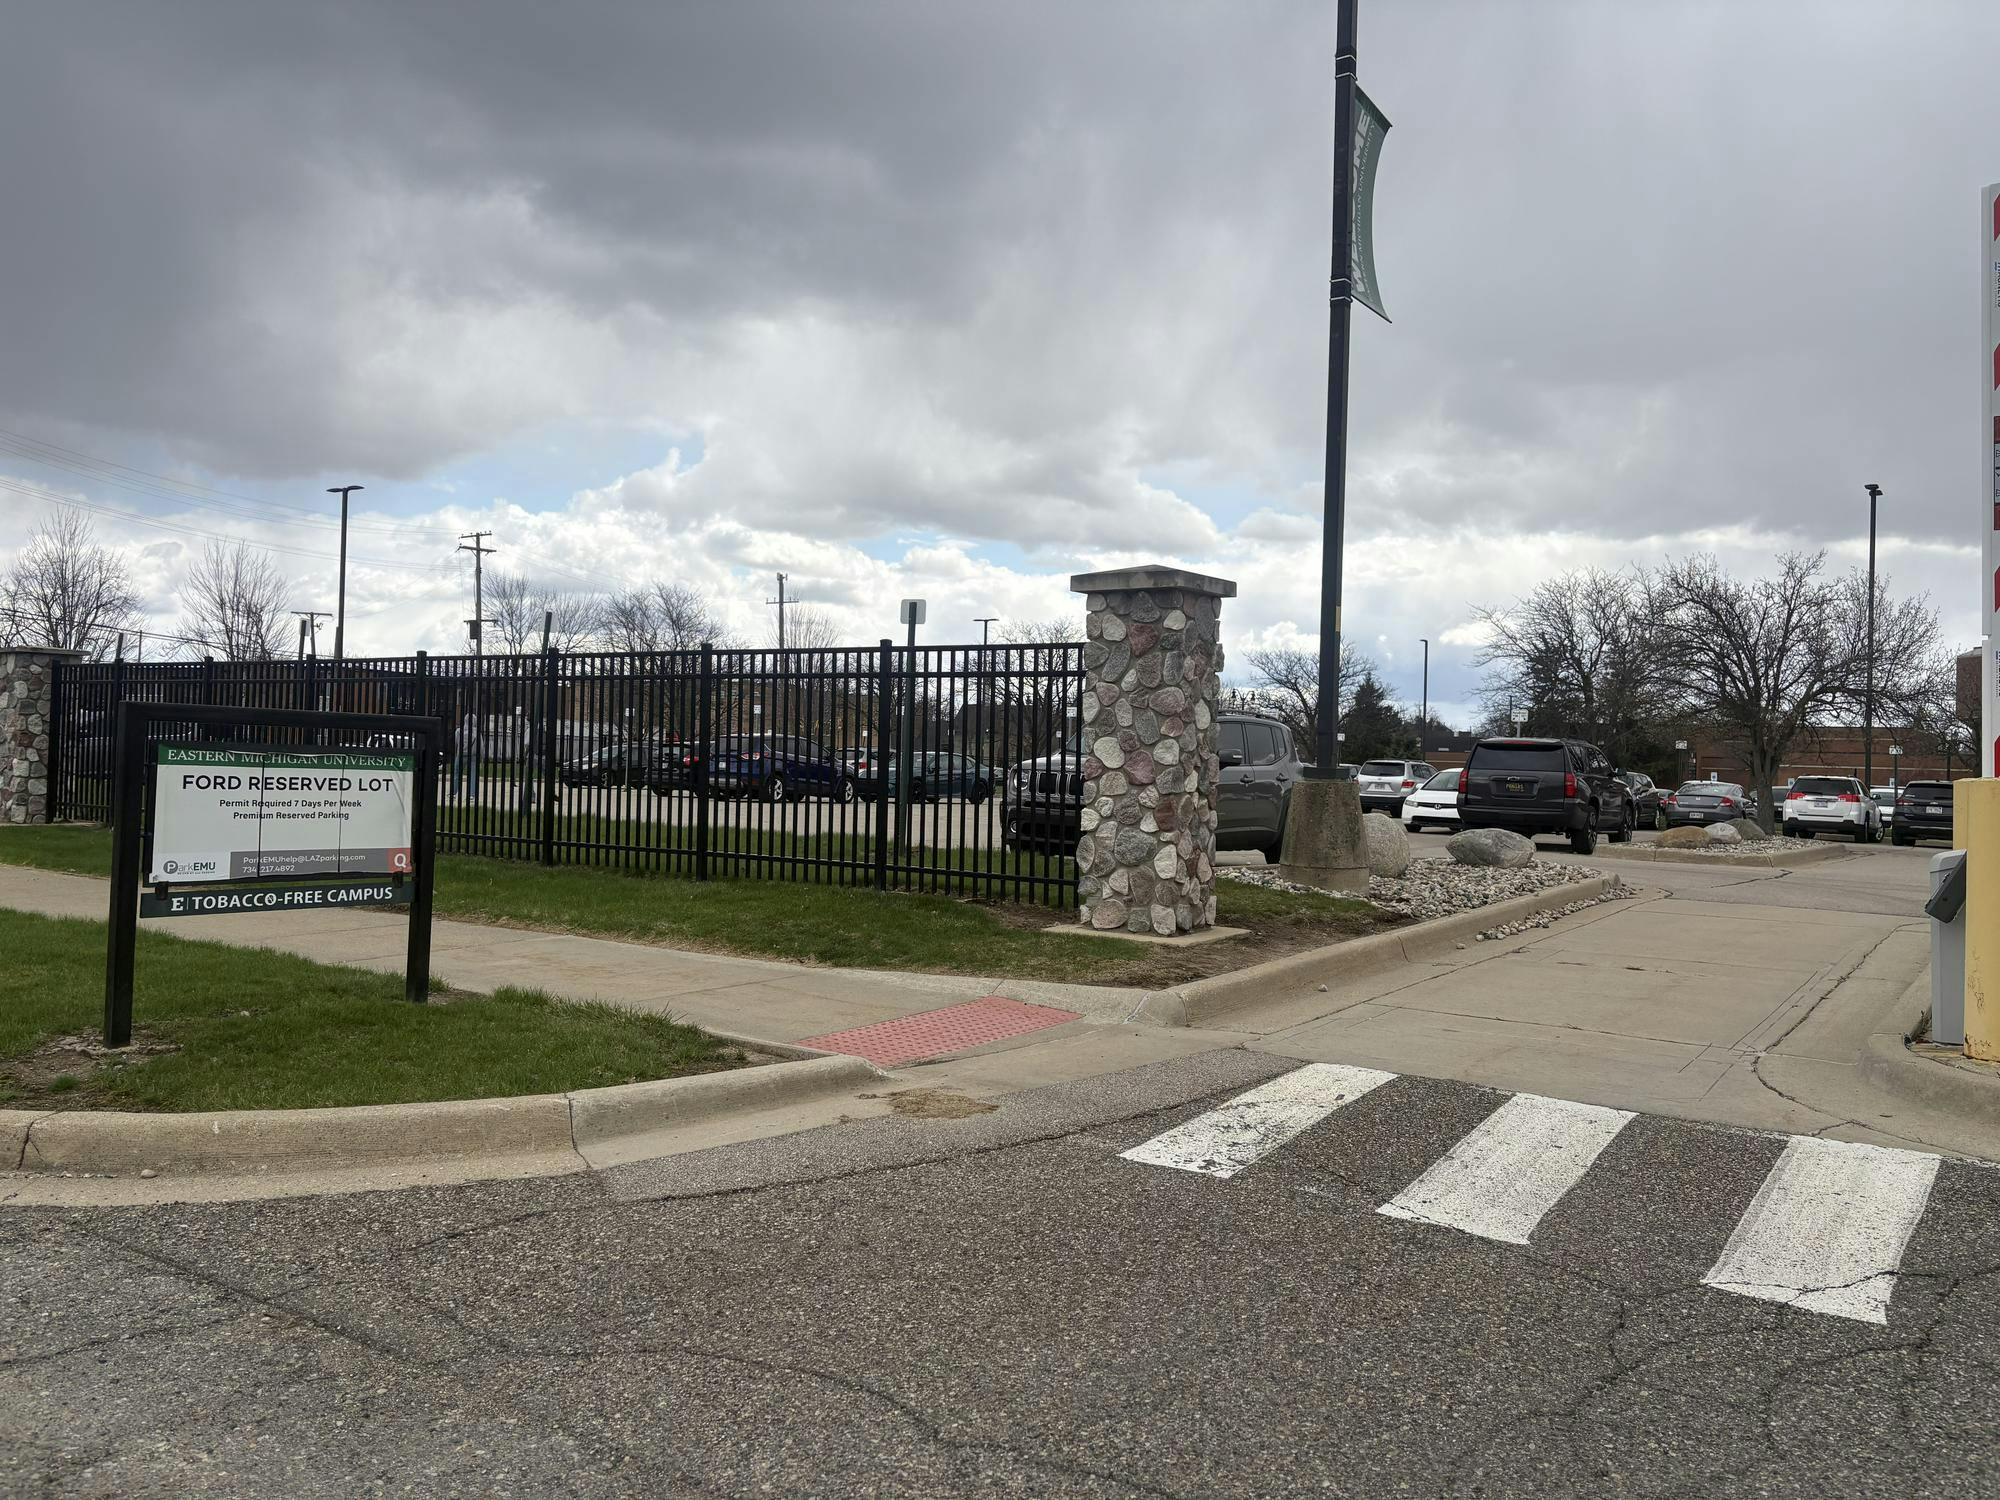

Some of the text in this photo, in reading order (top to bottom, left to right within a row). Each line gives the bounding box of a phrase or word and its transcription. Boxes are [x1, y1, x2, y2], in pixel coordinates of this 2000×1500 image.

[168, 749, 406, 767] EASTERN MICHIGAN UNIVERSITY
[182, 774, 393, 792] FORD RESERVED LOT
[251, 800, 292, 808] Required
[301, 800, 322, 808] Days
[233, 811, 350, 820] Premium Reserved Parking
[163, 861, 216, 874] ParkEMU
[394, 853, 406, 868] Q
[242, 865, 295, 873] 734217.4892
[170, 886, 393, 911] E TOBACCO-FREE CAMPUS
